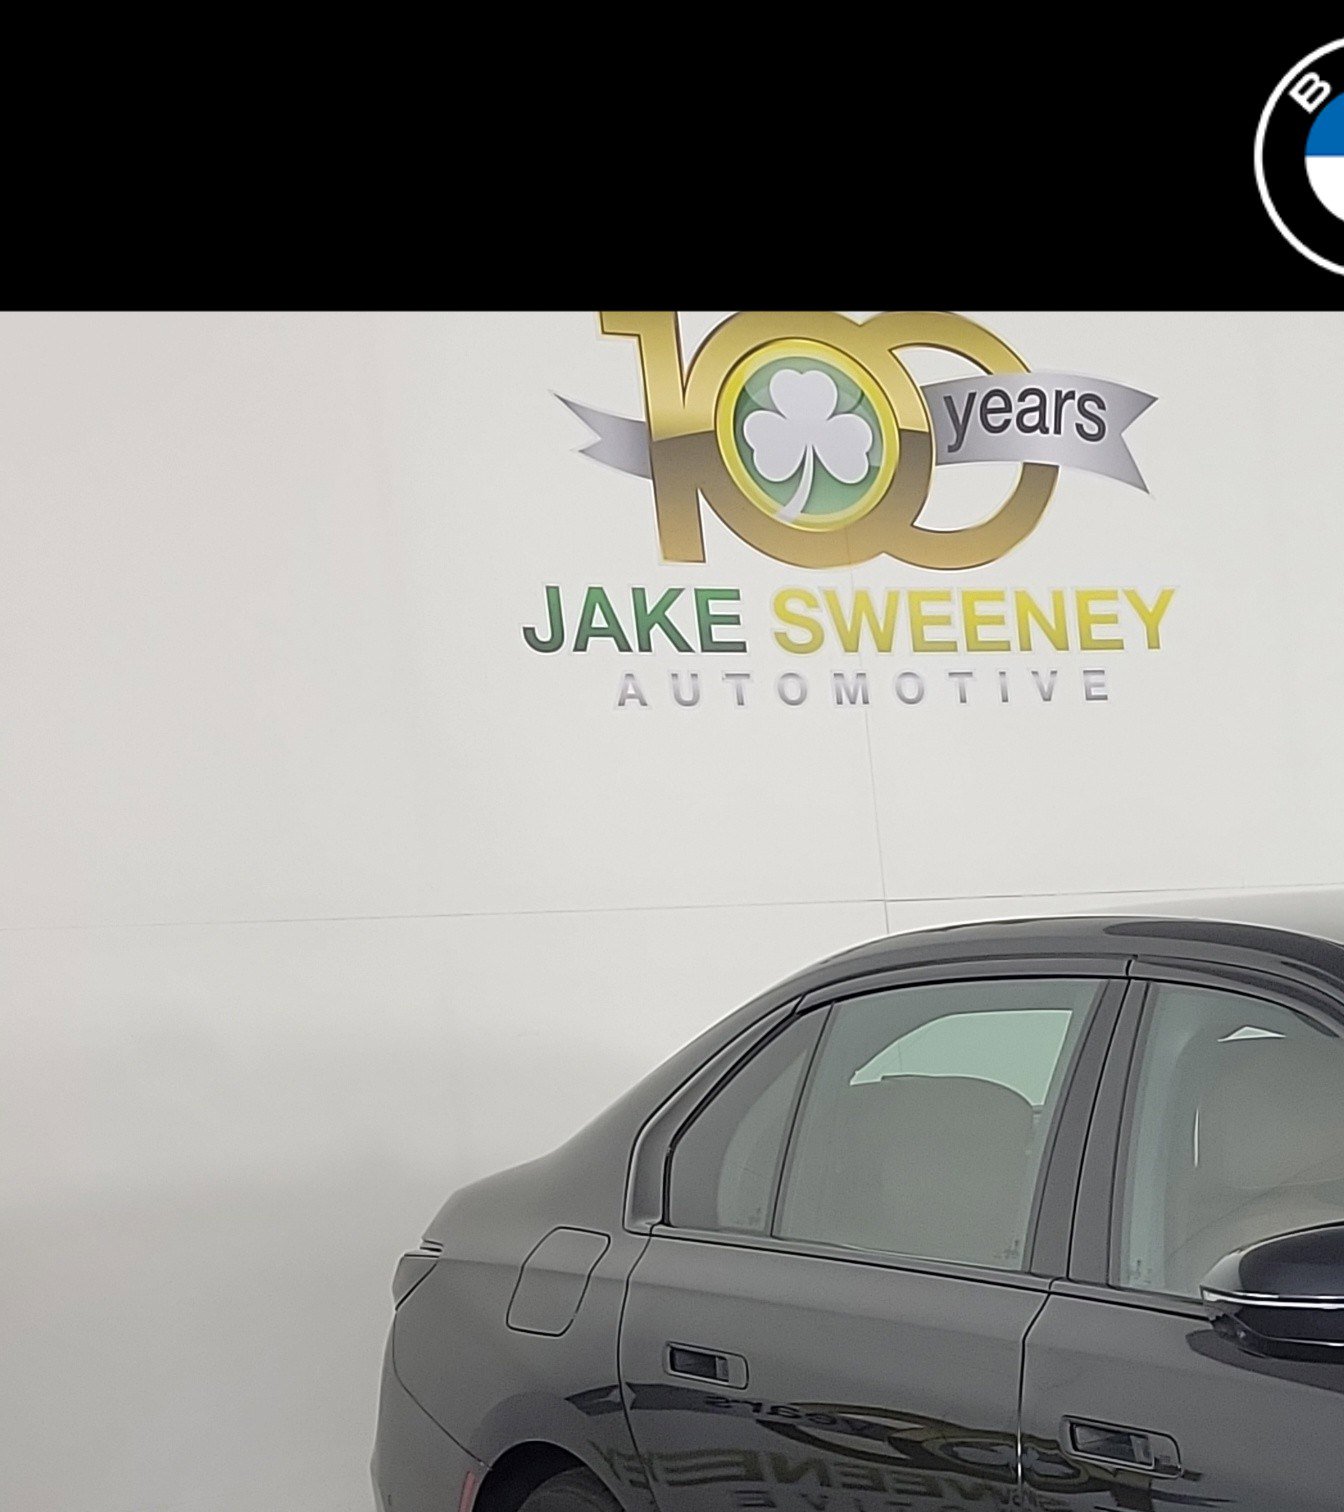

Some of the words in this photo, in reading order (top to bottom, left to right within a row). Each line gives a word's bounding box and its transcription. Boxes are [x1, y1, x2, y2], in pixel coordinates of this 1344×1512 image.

[943, 385, 1109, 454] years
[522, 585, 748, 654] JAKE
[772, 587, 1177, 654] SWEENEY
[616, 669, 1110, 708] AUTOMOTIVE
